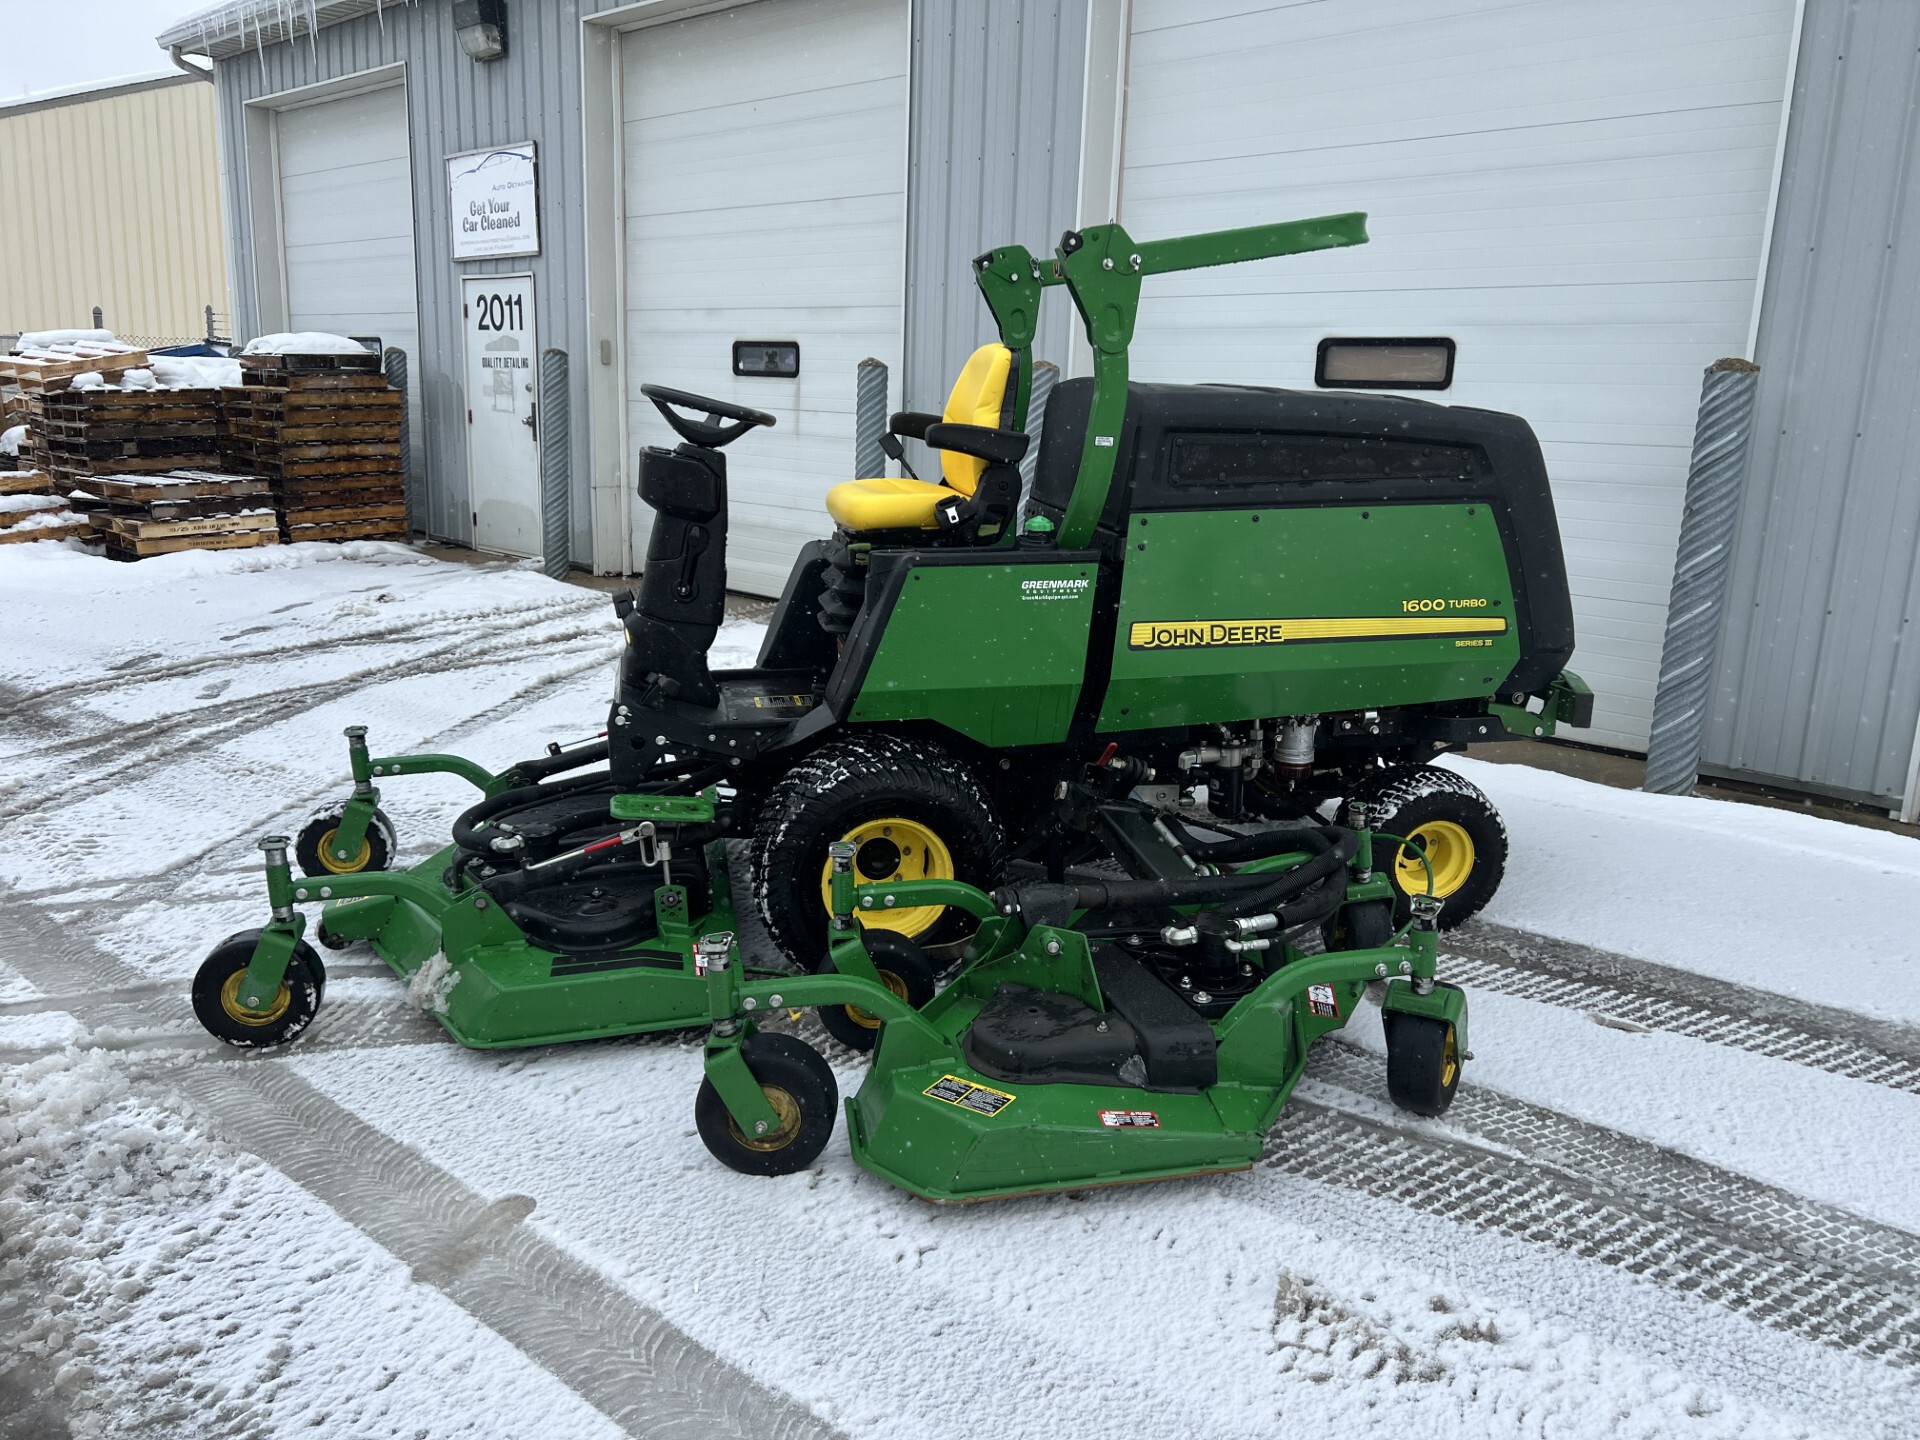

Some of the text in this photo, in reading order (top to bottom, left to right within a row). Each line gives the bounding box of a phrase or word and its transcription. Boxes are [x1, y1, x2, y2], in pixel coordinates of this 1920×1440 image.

[469, 197, 510, 216] Get Your
[462, 211, 520, 233] Car Cleaned
[476, 293, 524, 331] 2011
[1022, 580, 1089, 589] GREENMARK
[1401, 599, 1487, 612] 1600 TURBO
[1143, 622, 1283, 647] JOHN DEERE
